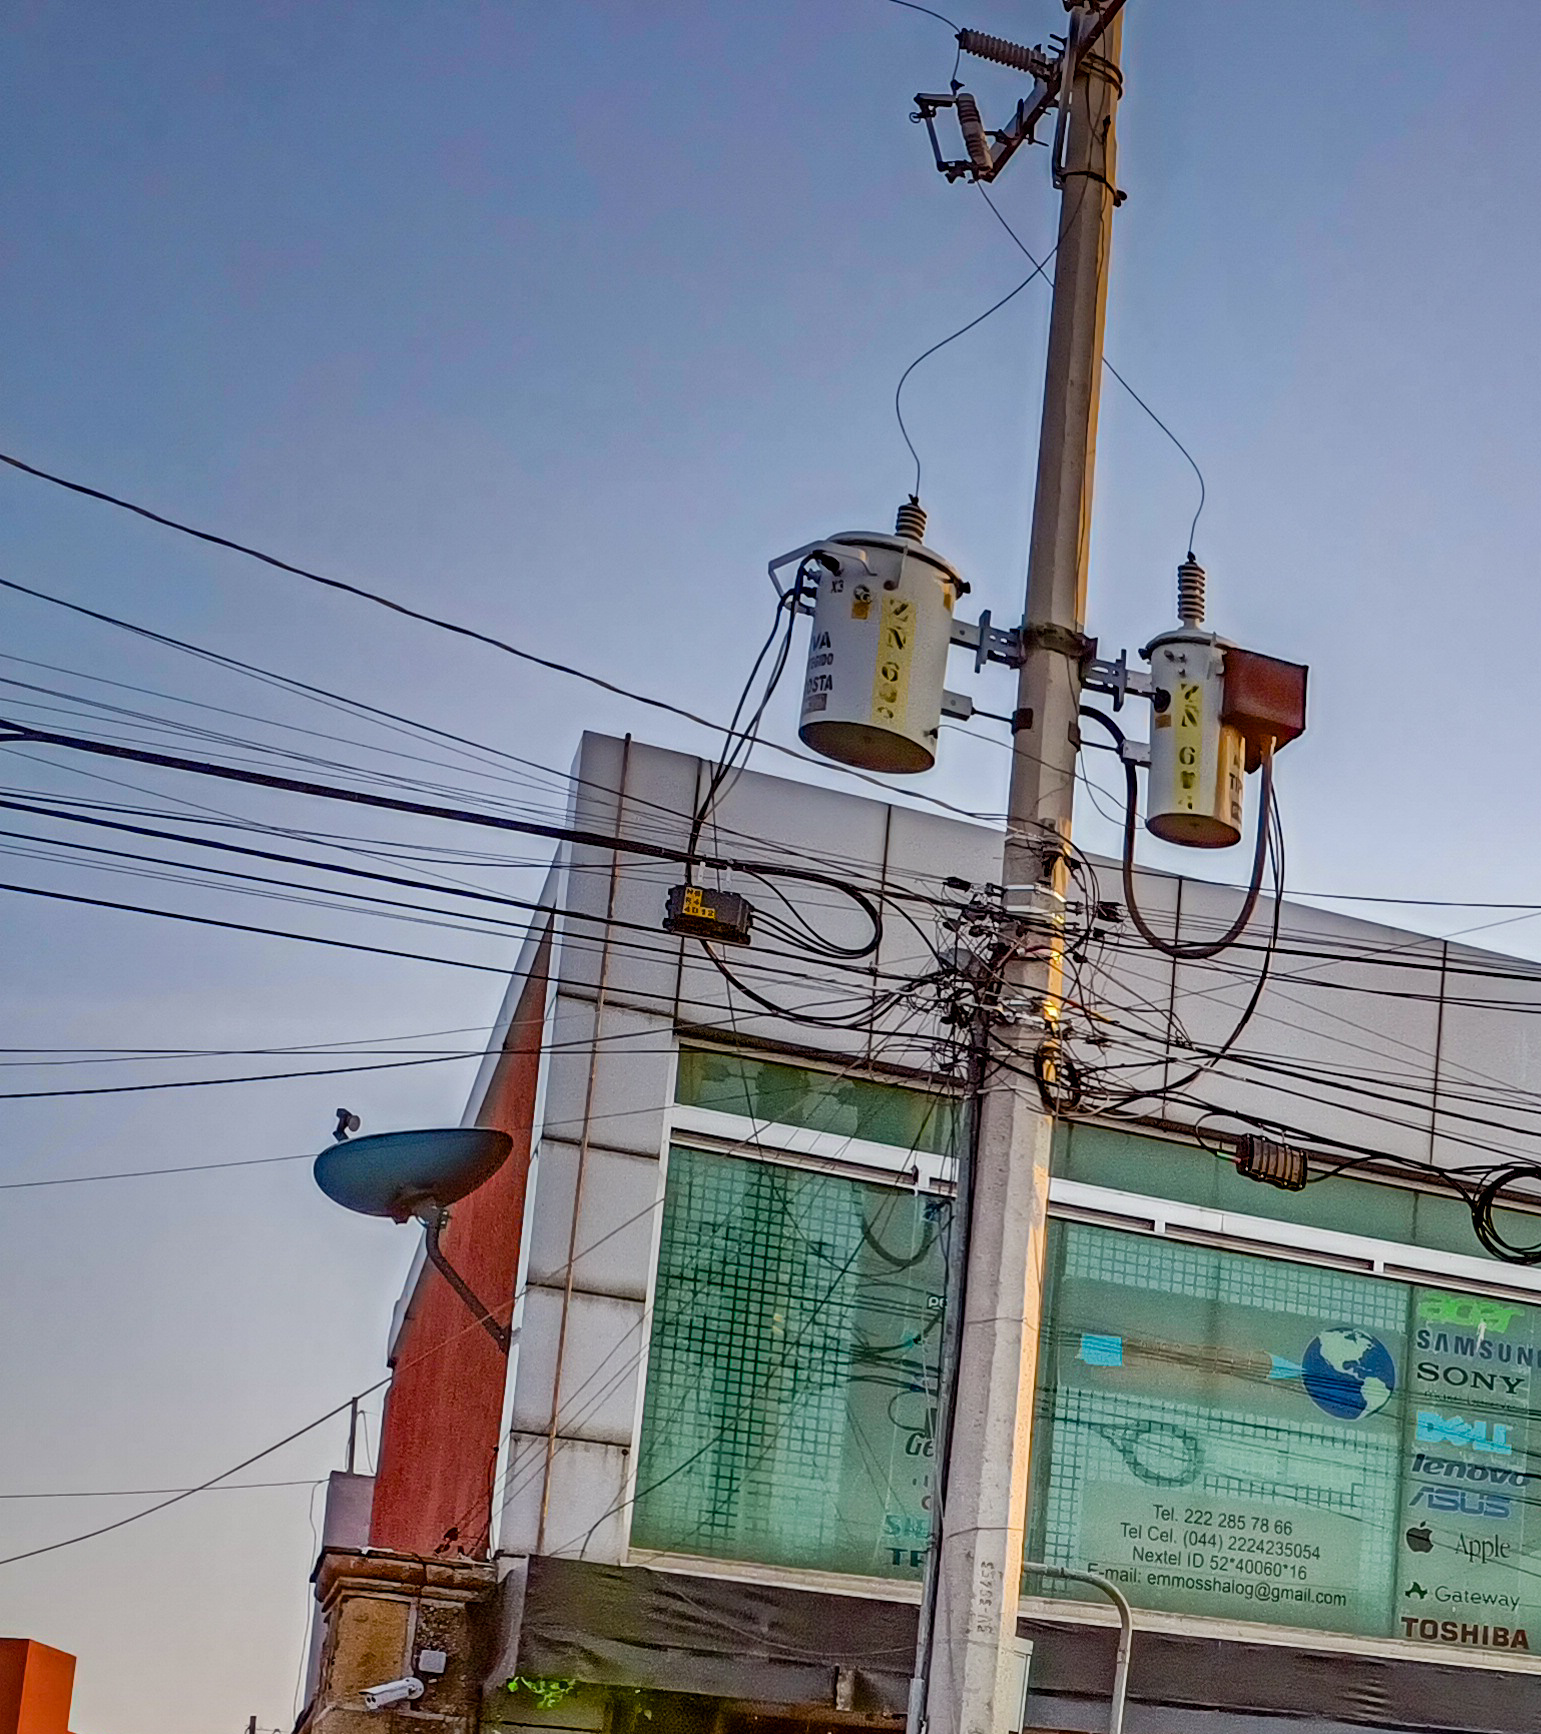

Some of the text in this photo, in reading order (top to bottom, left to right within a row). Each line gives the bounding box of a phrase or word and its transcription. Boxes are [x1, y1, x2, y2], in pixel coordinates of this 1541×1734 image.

[1416, 1361, 1525, 1395] SONY
[1415, 1410, 1513, 1455] DELL
[1411, 1453, 1531, 1487] lenovo
[1408, 1485, 1511, 1519] ASUS
[1153, 1504, 1293, 1536] Tel. 222 285 78 66
[1120, 1522, 1321, 1561] Tel Cel. (044) 2224235054
[1132, 1545, 1182, 1566] Nextel
[1186, 1552, 1205, 1568] ID
[1455, 1532, 1511, 1565] Apple
[1087, 1562, 1348, 1607] E-mail: emmosshalog@gmail.com
[1434, 1585, 1521, 1612] Gateway
[1400, 1616, 1530, 1650] TOSHIBA
